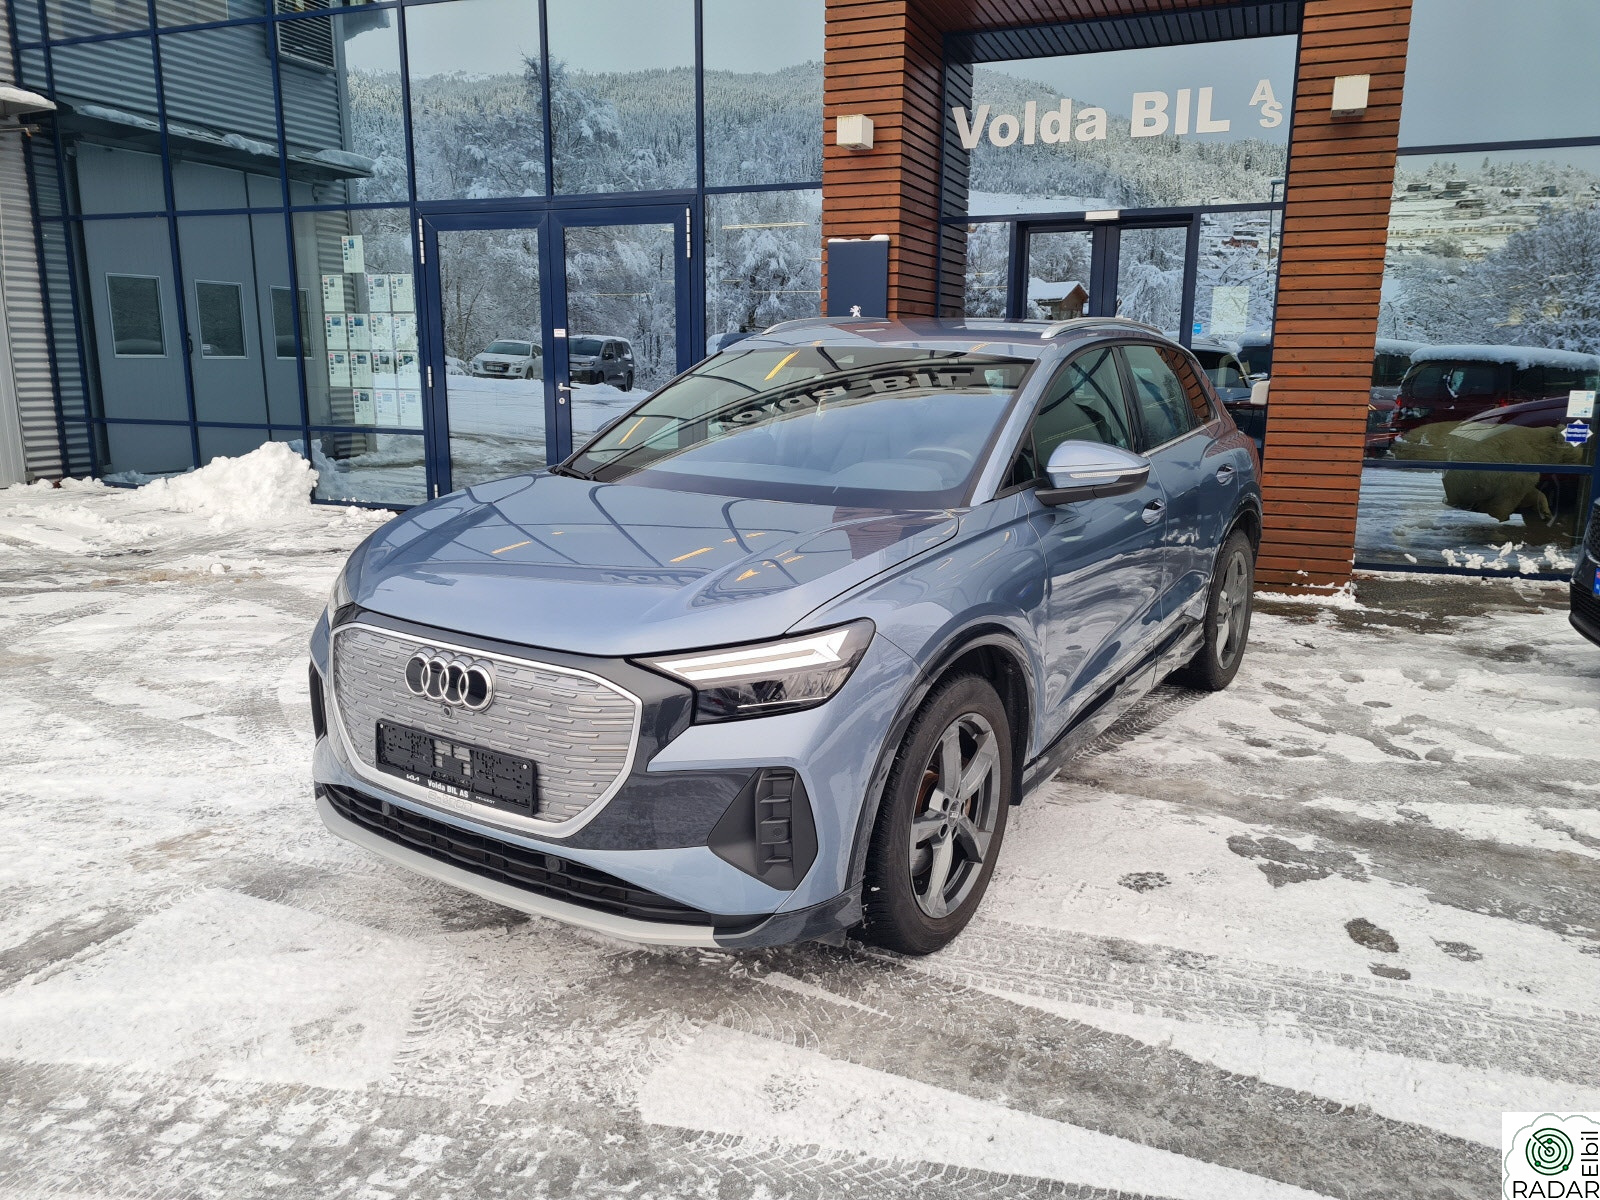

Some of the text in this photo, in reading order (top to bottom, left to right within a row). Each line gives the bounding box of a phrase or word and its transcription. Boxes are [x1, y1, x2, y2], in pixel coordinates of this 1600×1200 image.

[952, 99, 1107, 149] Volda
[1130, 87, 1230, 138] BIL
[427, 779, 469, 799] Volda BIL AS
